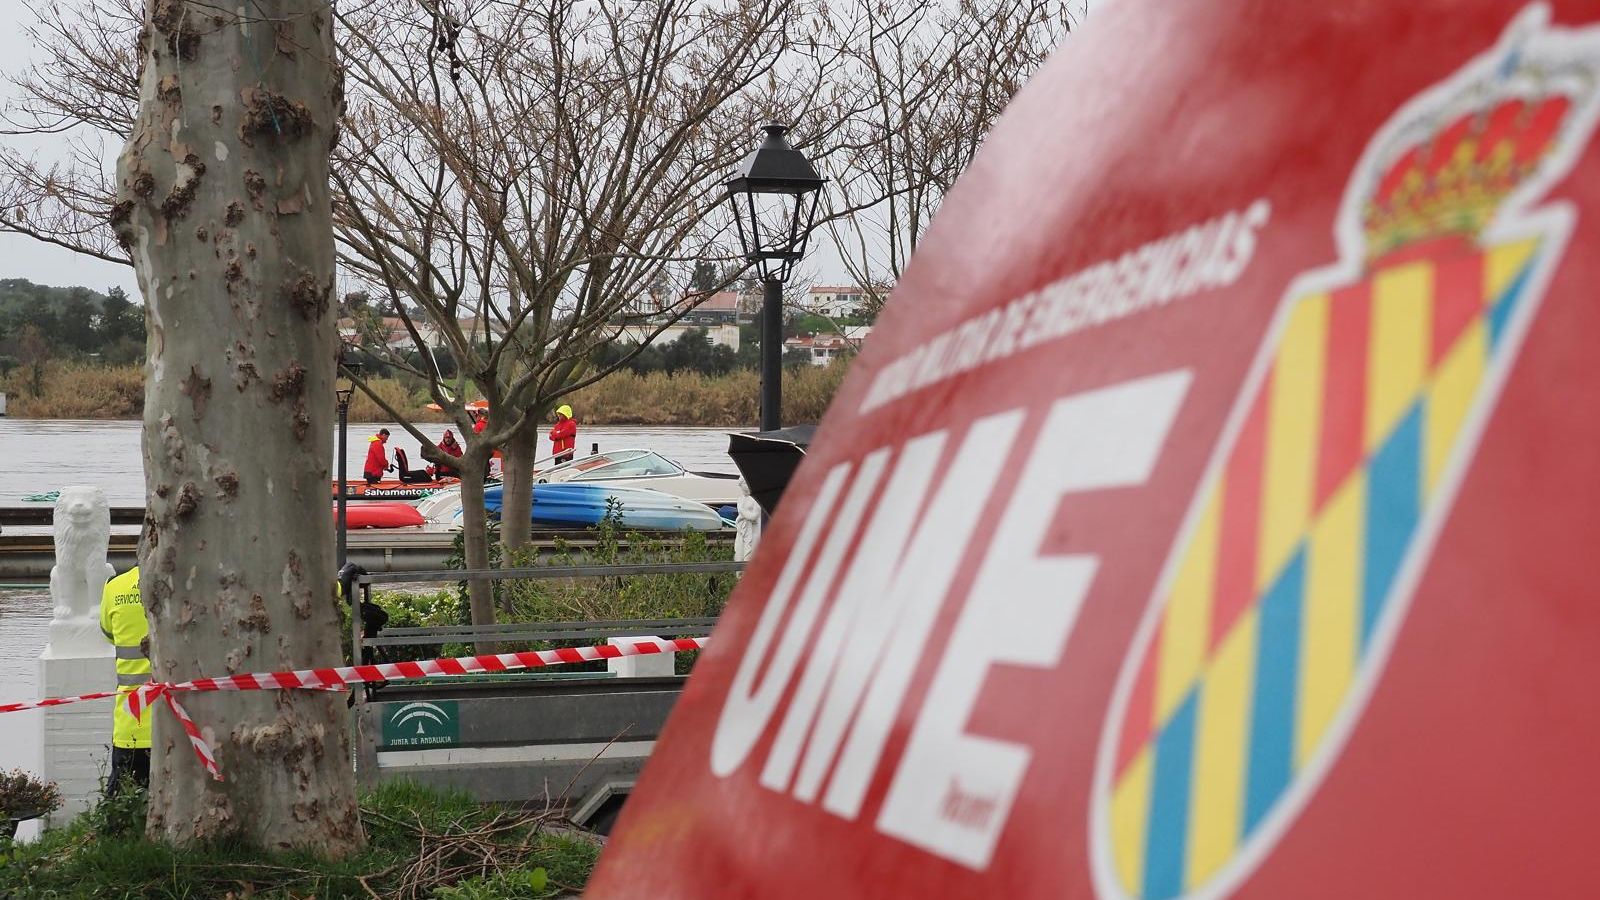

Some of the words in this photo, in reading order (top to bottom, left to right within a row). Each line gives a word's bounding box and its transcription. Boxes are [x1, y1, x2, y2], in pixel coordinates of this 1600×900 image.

[364, 488, 421, 496] Salvamento
[710, 367, 1193, 873] UME
[410, 737, 418, 745] DE
